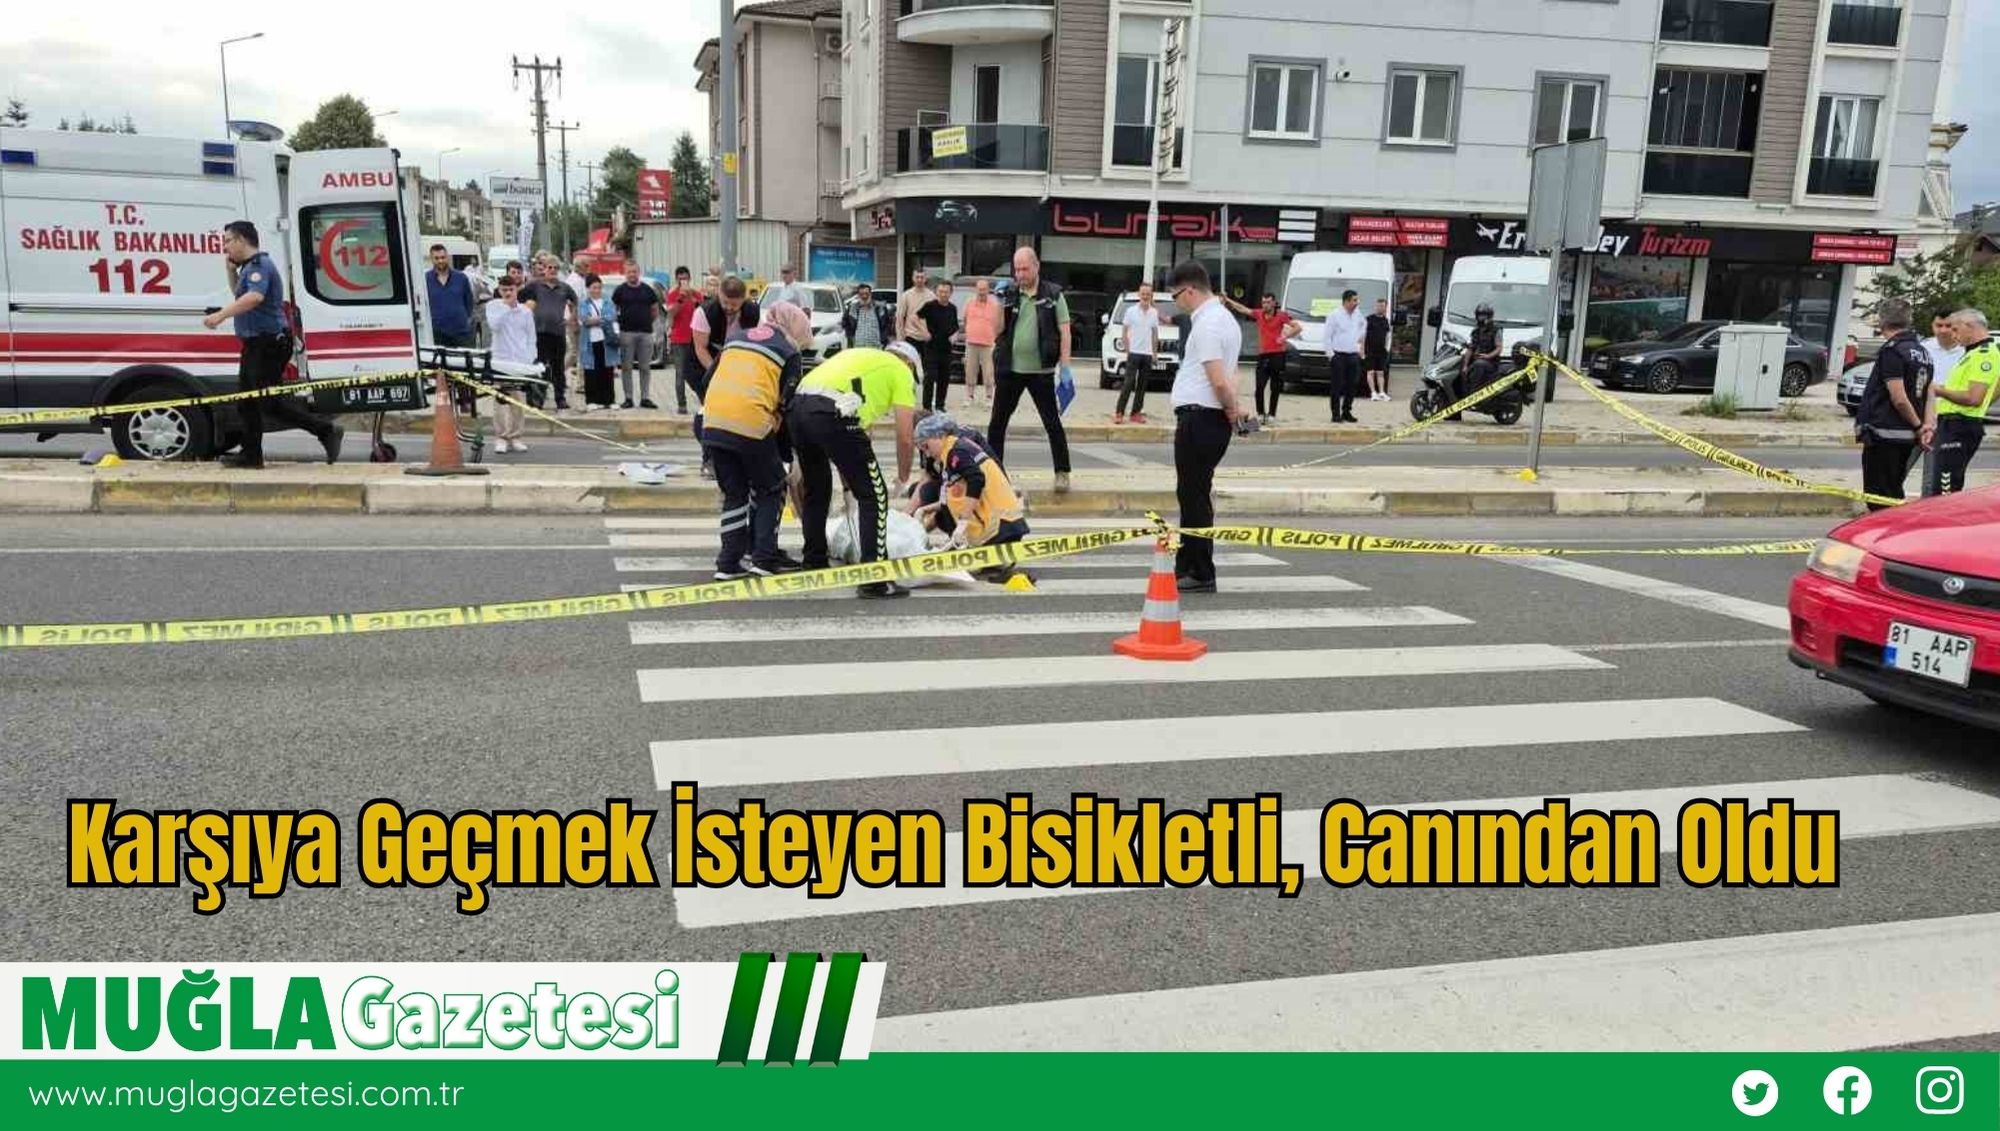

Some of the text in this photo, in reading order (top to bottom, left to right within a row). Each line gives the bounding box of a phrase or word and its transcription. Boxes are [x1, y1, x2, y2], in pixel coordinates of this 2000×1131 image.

[322, 172, 393, 187] AMBU
[105, 204, 144, 225] T.C.
[21, 225, 100, 251] SAĞLIK
[1640, 226, 1711, 256] Turizm
[335, 246, 389, 267] 112
[89, 258, 171, 294] 112
[1892, 624, 1968, 657] 81 AAP
[1911, 651, 1941, 674] 514
